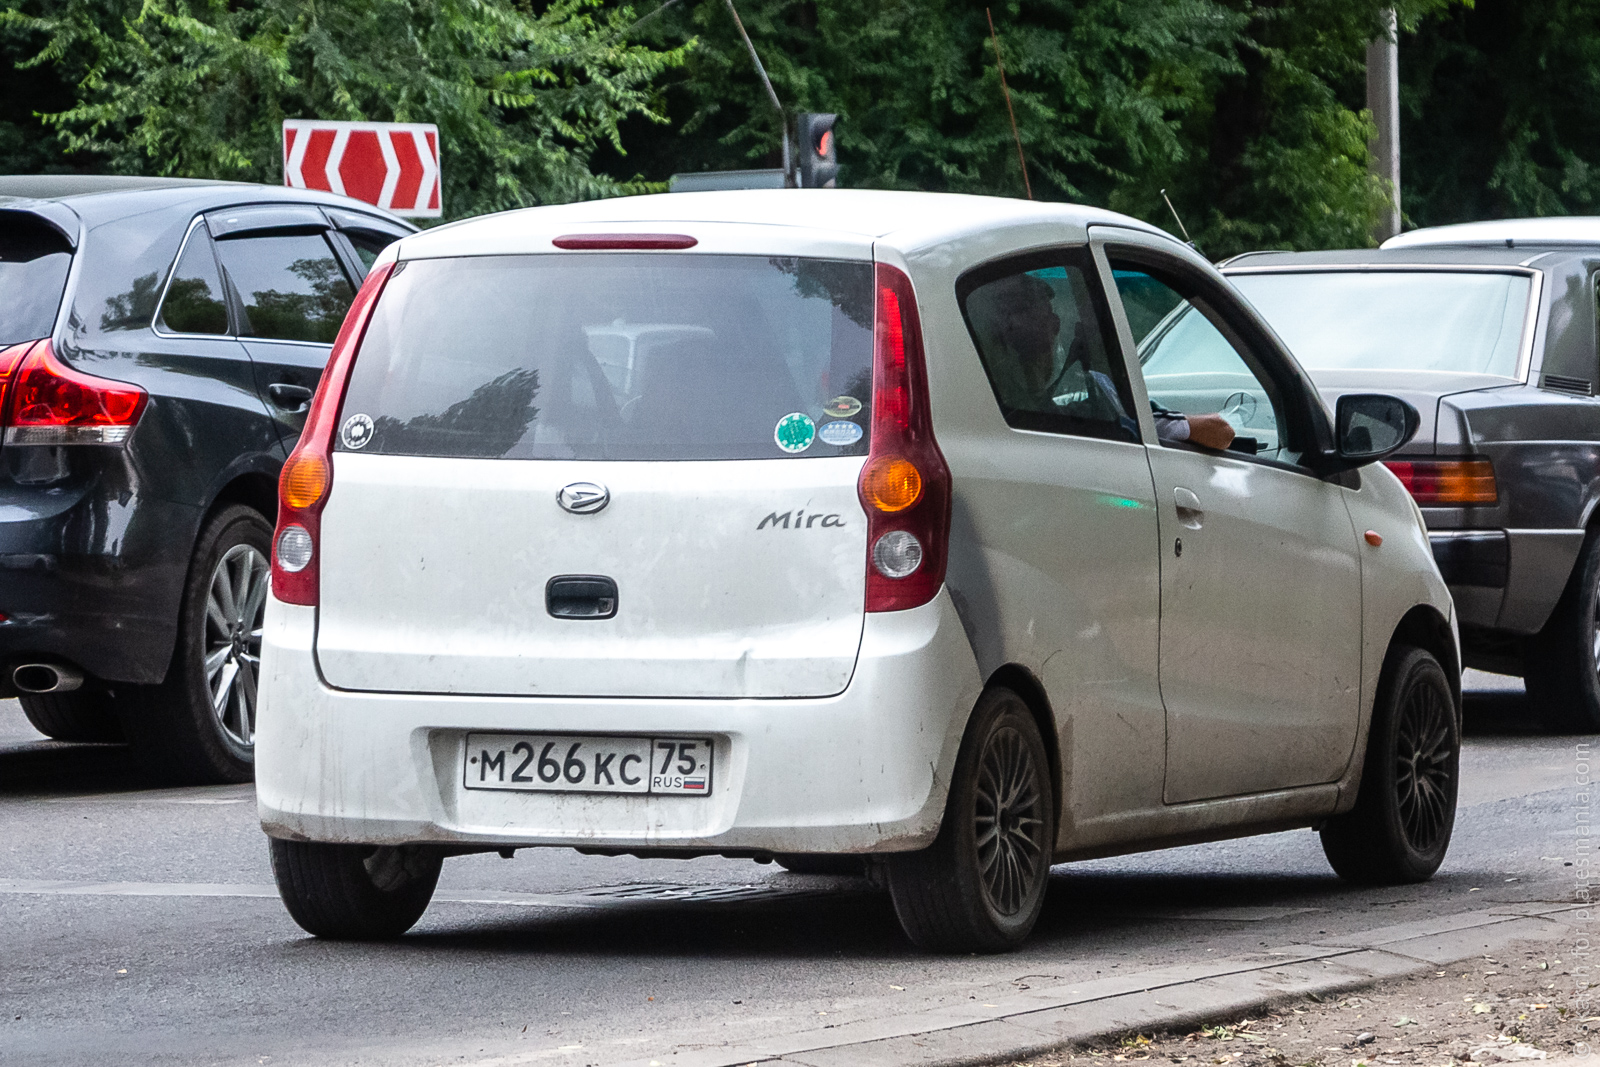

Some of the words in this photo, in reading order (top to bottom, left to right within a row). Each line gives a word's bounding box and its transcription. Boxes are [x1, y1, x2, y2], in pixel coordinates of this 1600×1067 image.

[756, 509, 847, 530] Mira
[657, 742, 697, 775] 75
[653, 776, 682, 788] RUS
